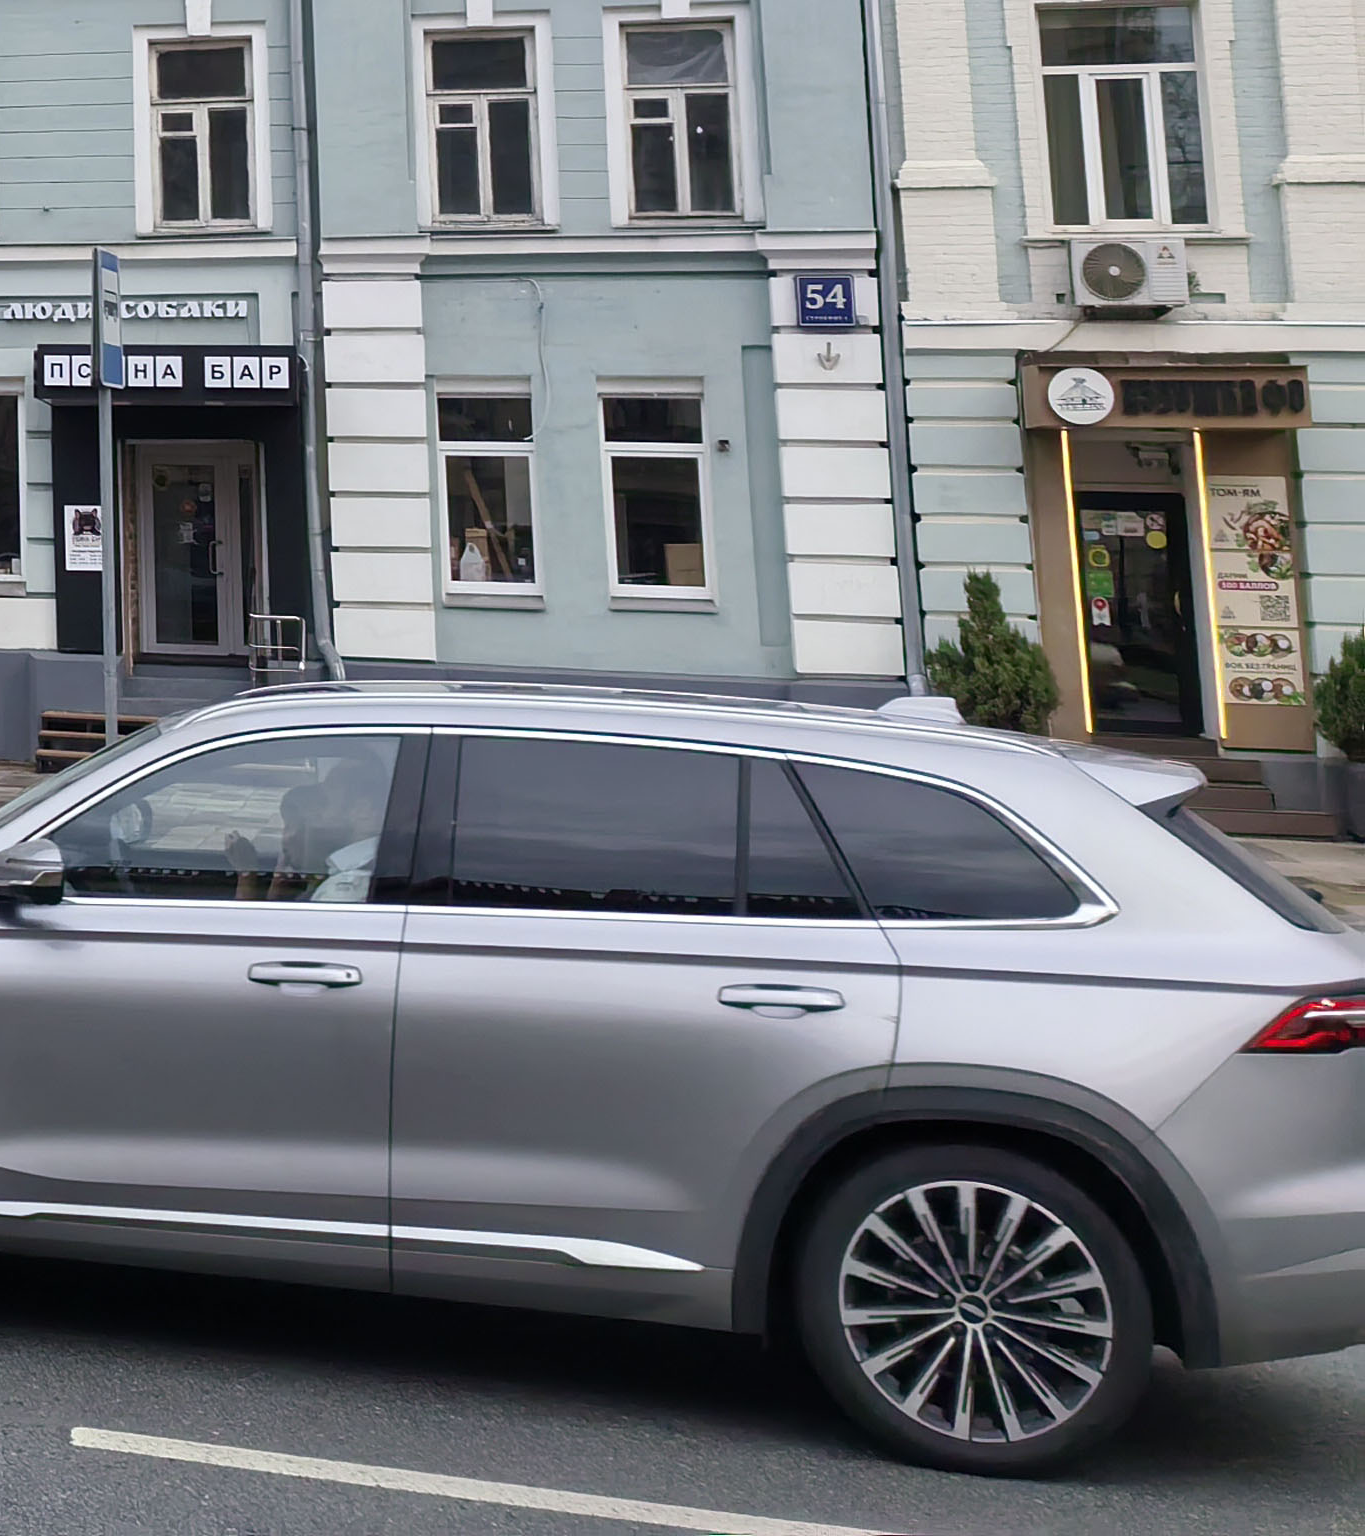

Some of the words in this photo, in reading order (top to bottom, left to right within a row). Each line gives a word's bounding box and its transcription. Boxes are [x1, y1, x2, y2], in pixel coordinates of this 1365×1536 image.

[805, 283, 847, 310] 54
[120, 299, 249, 319] СОБАКИ
[49, 361, 177, 380] ПСНА
[210, 363, 282, 381] БАР
